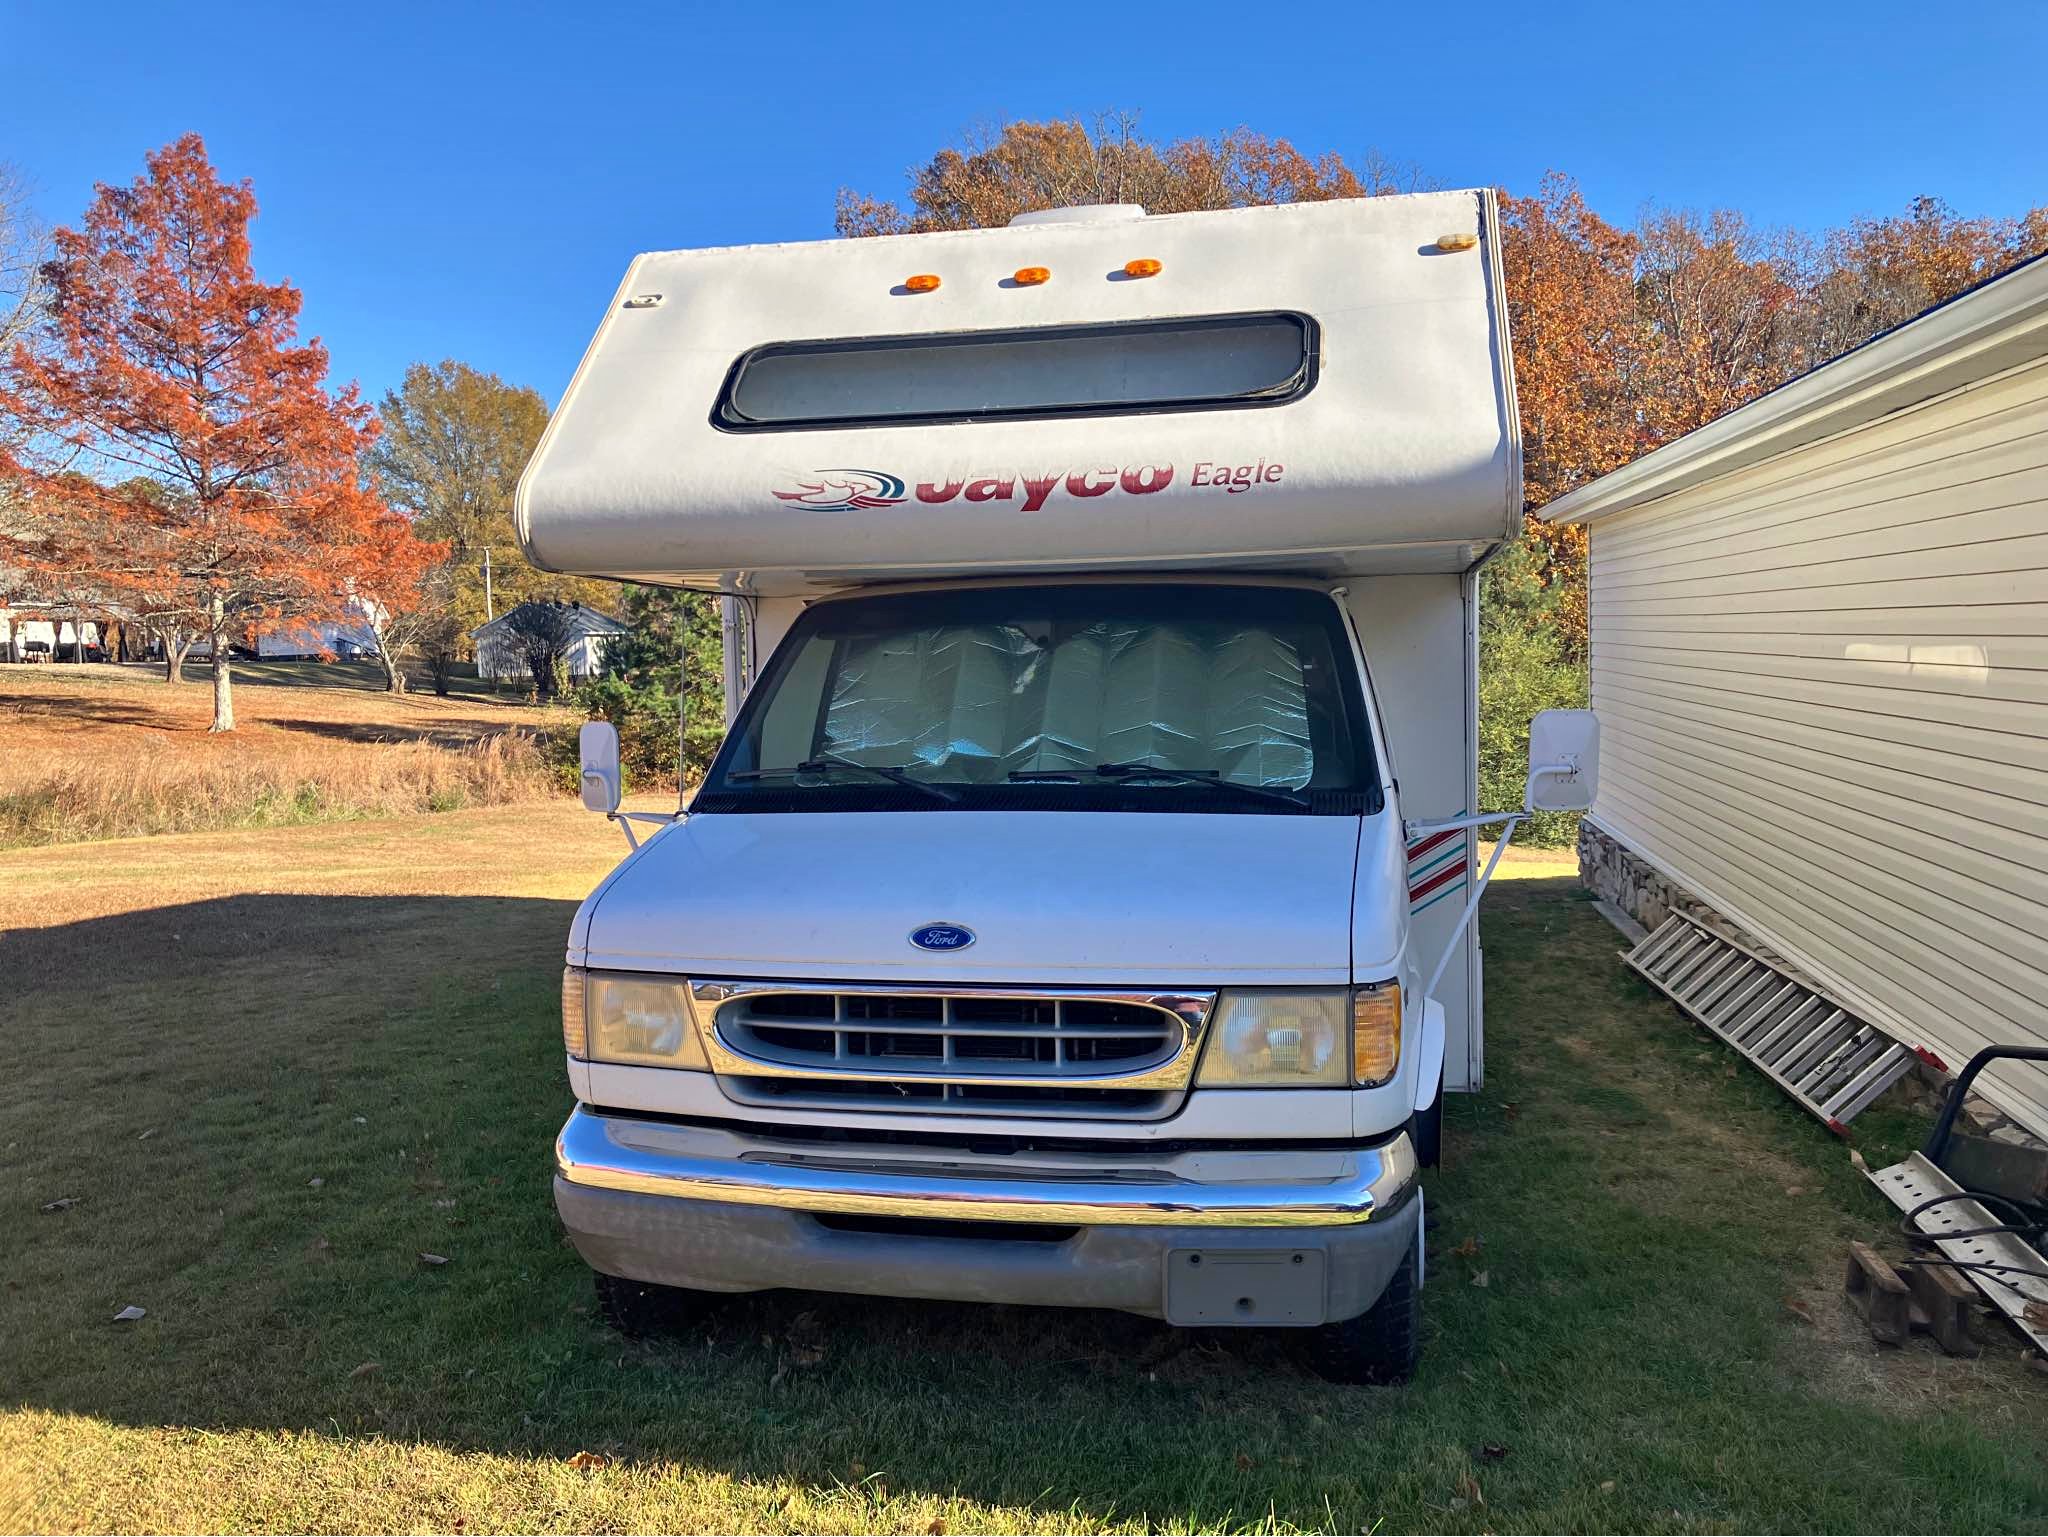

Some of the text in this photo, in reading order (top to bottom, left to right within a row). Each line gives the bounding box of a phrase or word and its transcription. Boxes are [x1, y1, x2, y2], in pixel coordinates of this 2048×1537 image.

[915, 456, 1284, 512] Jayco Eagle
[924, 929, 959, 945] Ford
